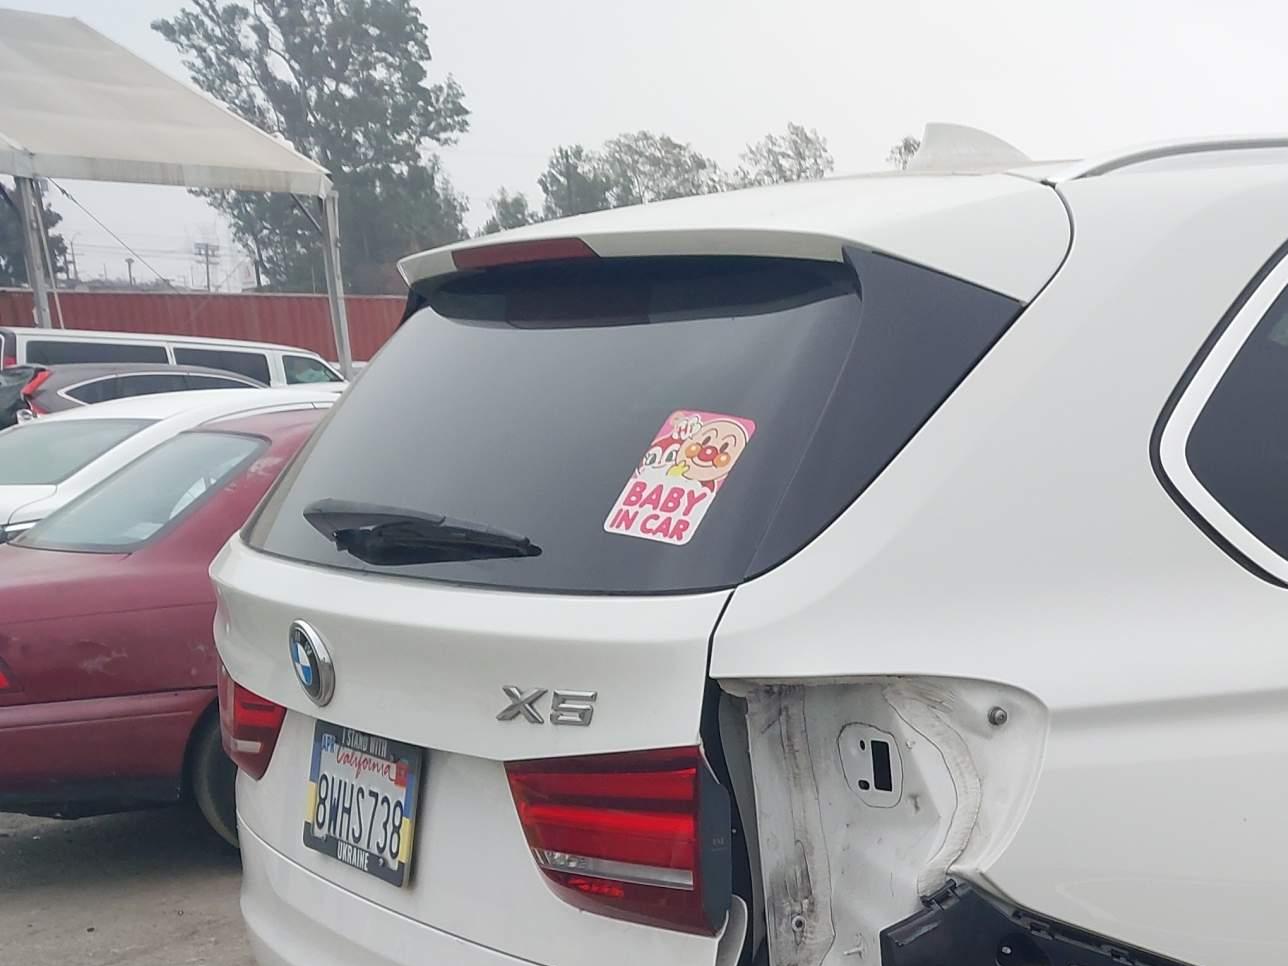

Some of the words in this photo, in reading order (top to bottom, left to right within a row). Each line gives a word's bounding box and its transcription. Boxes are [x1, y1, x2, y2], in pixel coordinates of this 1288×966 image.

[622, 480, 708, 517] BABY
[609, 508, 639, 530] IN
[639, 513, 690, 541] CAR
[495, 684, 598, 727] X5
[346, 729, 369, 752] STAND
[369, 736, 388, 759] WITH
[336, 746, 396, 783] California
[315, 773, 404, 860] 8WHS738
[337, 841, 370, 871] UKRAINE
